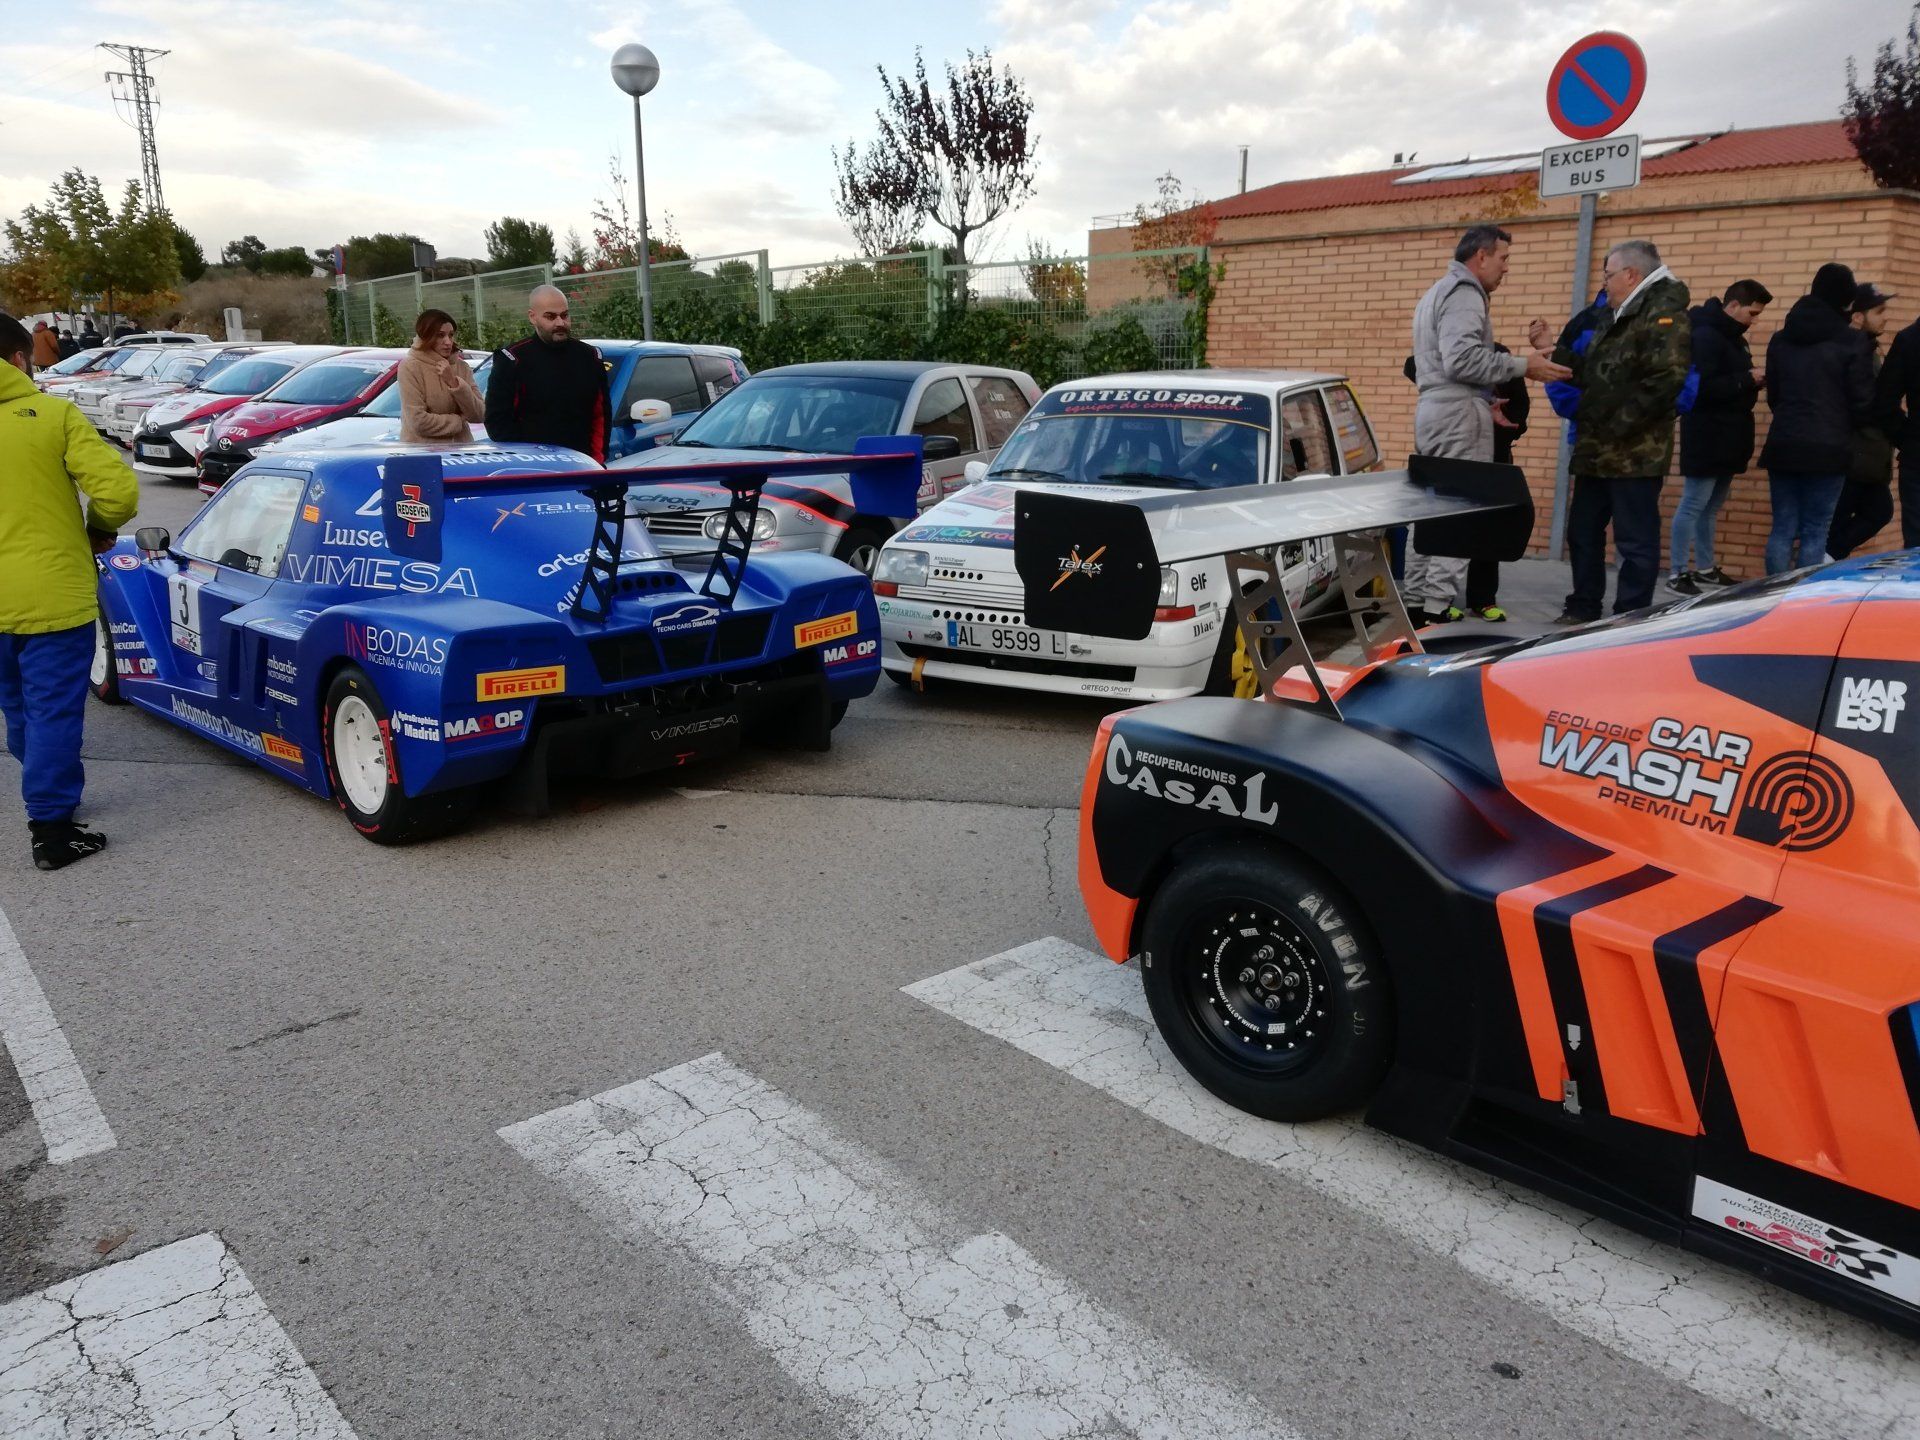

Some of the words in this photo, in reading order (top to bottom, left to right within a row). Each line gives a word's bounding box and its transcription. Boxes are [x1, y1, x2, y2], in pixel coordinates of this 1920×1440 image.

[1549, 143, 1630, 168] EXCEPTO
[1569, 169, 1605, 186] BUS
[1059, 389, 1172, 403] ORTEGO
[1173, 391, 1243, 406] sport
[1119, 401, 1141, 410] de
[397, 502, 429, 518] REDSEVEN
[528, 502, 596, 513] Tale
[120, 556, 132, 565] E
[1058, 557, 1103, 571] Talex
[288, 553, 479, 597] VIMESA
[1191, 572, 1207, 592] elf
[177, 580, 190, 626] 3
[109, 622, 137, 634] ubriCar
[657, 625, 676, 633] TECNO
[676, 622, 692, 632] CARS
[799, 616, 852, 643] PIRELLI
[958, 625, 981, 647] AL
[991, 628, 1040, 652] 9599
[1051, 633, 1065, 655] L
[1193, 619, 1214, 638] Diac
[267, 655, 297, 676] mbardic
[367, 652, 396, 668] INGENIA
[397, 661, 404, 669] &
[405, 661, 442, 677] INNOVA
[484, 671, 558, 696] PIRELLI
[1081, 684, 1109, 692] ORTEGO
[171, 694, 223, 736] Automotor
[222, 715, 265, 753] Dursan
[404, 724, 440, 742] Madrid
[651, 714, 739, 741] VIMESA
[1546, 710, 1643, 742] ECOLOGIC
[1648, 717, 1753, 767] CAR
[1106, 733, 1279, 825] CASAL
[1136, 750, 1237, 785] RECUPERACIONES
[1539, 723, 1744, 818] WASH
[1597, 786, 1727, 835] PREMIUM
[1298, 892, 1371, 991] AVON
[1225, 1002, 1243, 1021] ALLOY
[1241, 1018, 1261, 1033] WHEEL
